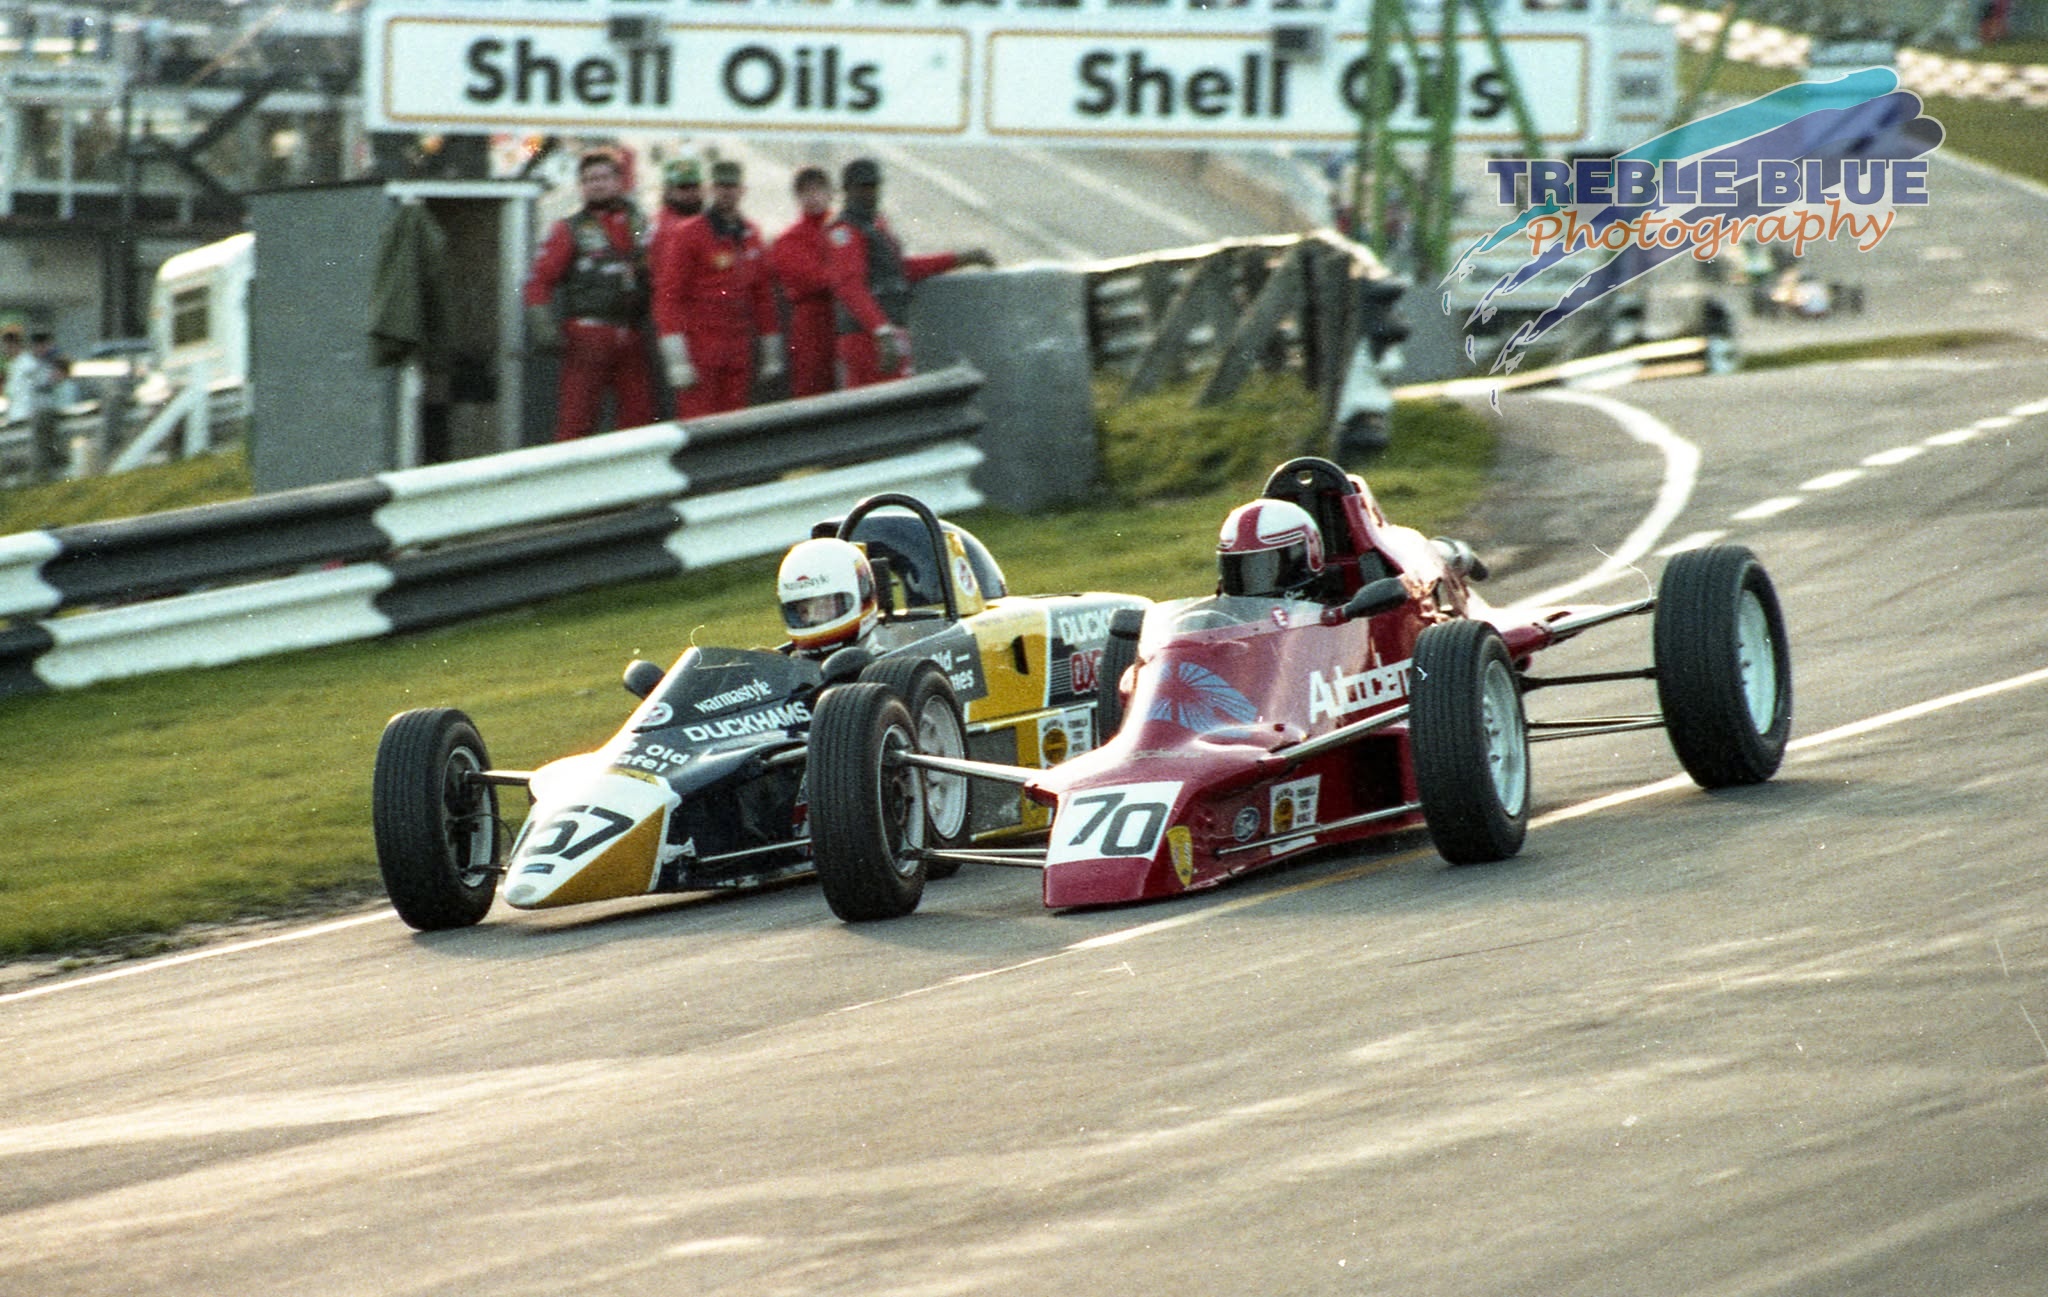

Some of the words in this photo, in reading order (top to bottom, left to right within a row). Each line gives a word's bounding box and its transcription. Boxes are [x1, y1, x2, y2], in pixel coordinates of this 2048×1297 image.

[464, 38, 671, 106] Shell
[721, 45, 882, 111] Oils
[1075, 51, 1291, 118] Shell
[1339, 54, 1514, 121] Ois
[693, 678, 773, 714] warmastyle
[682, 701, 814, 742] DUCKHAMS
[614, 754, 670, 773] afe!
[645, 744, 691, 766] Old
[1068, 792, 1169, 857] 70
